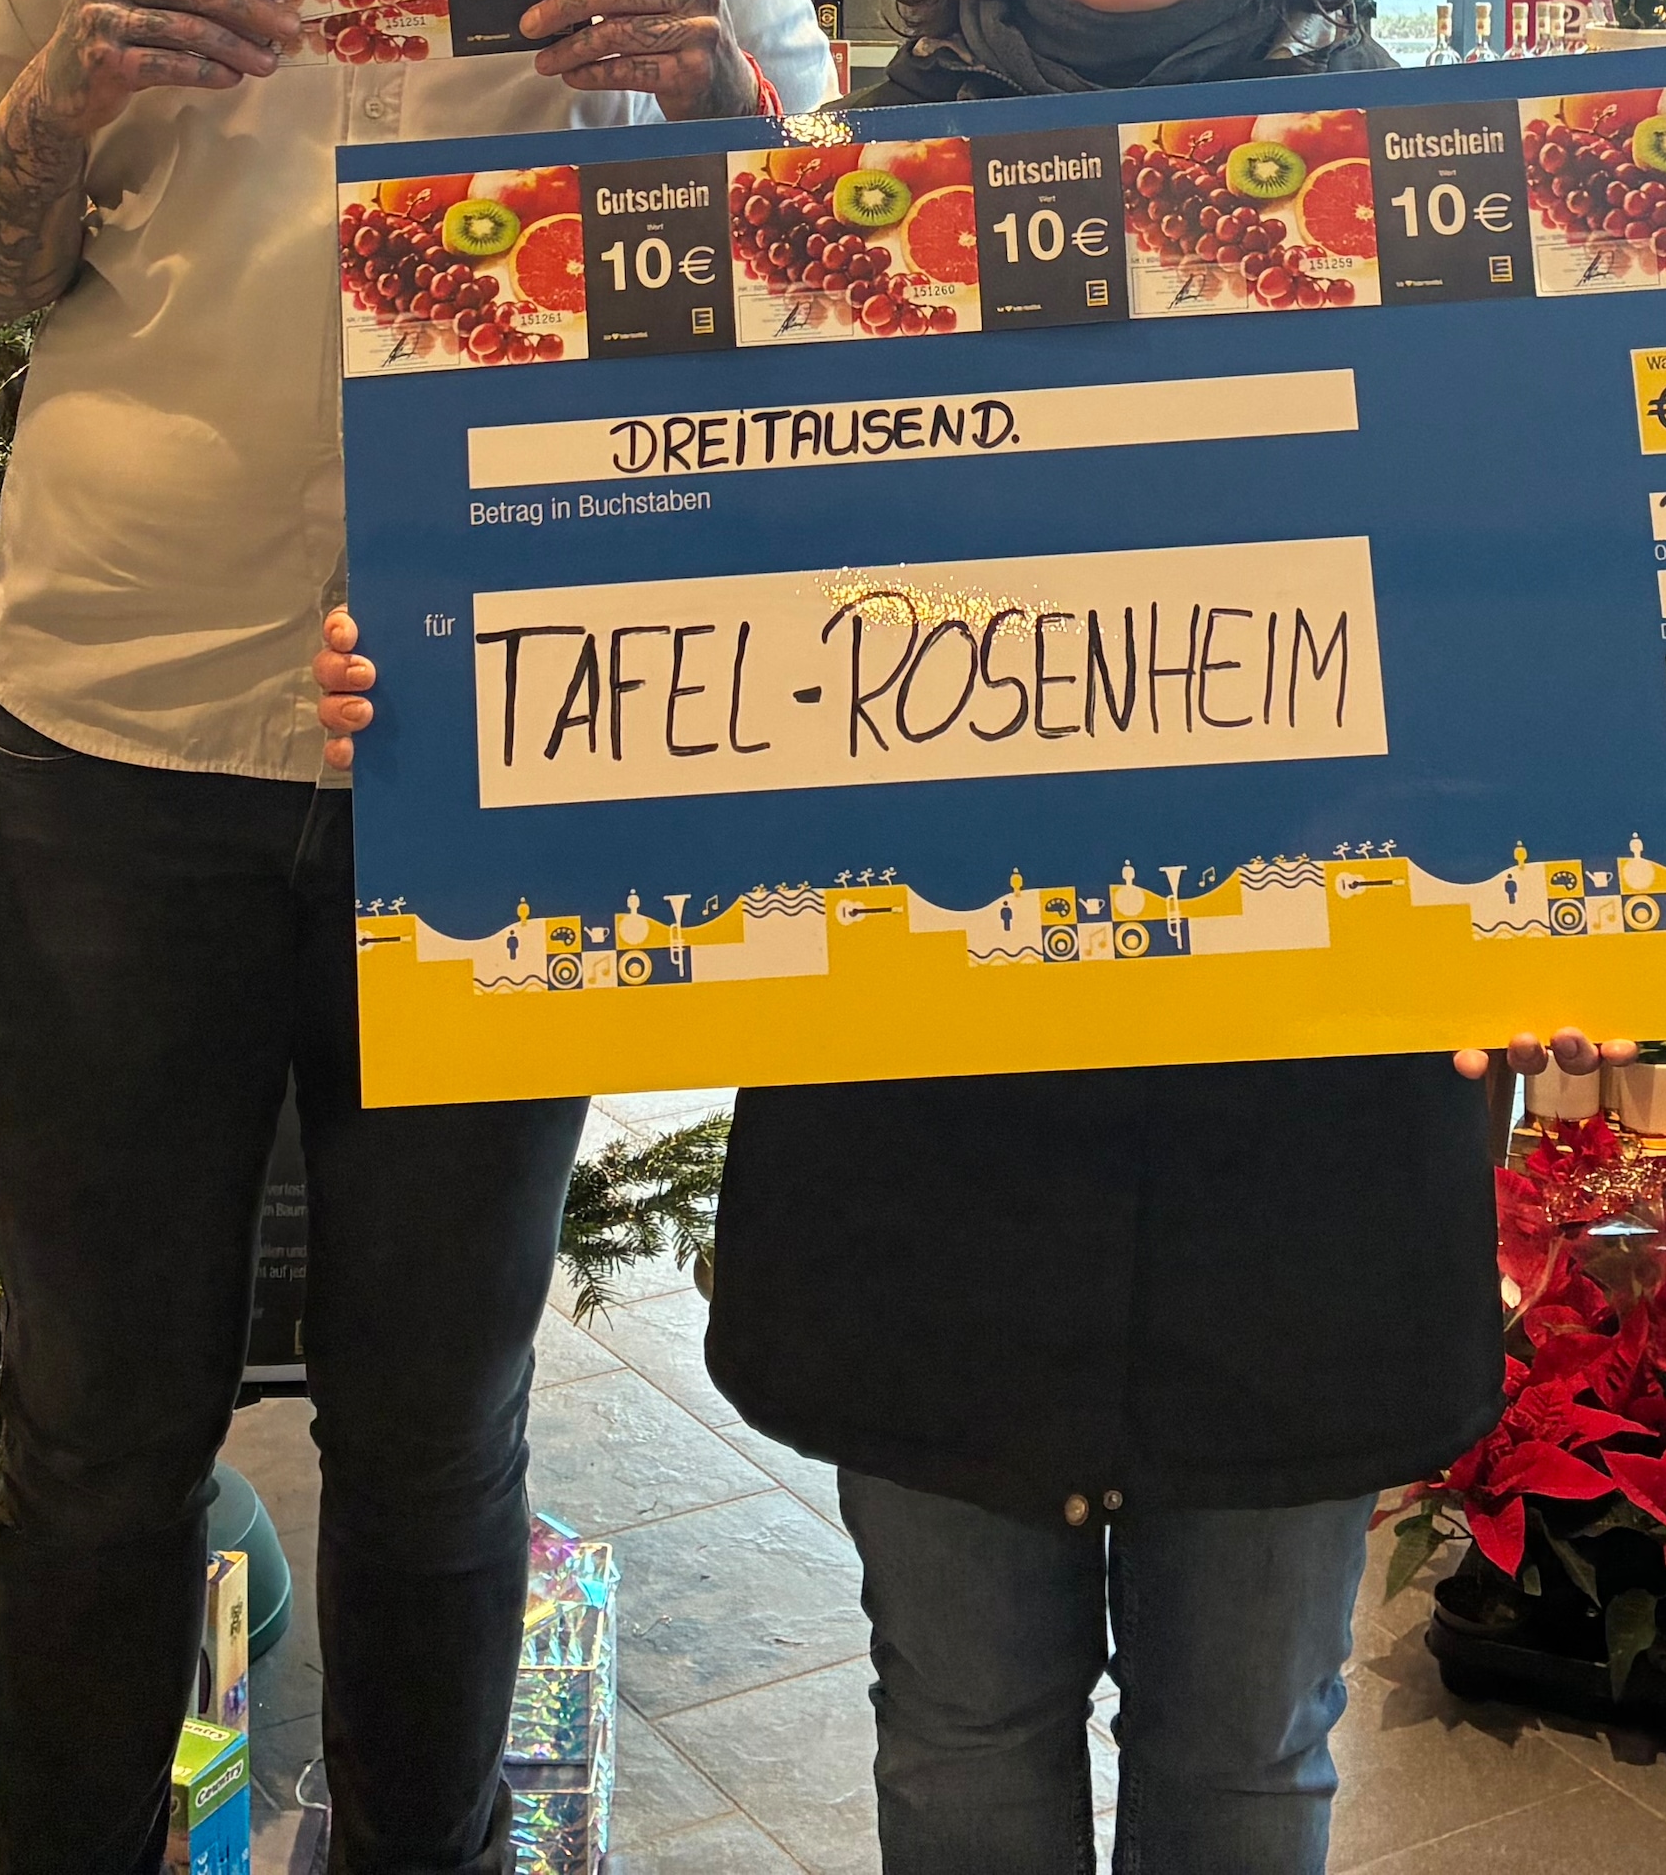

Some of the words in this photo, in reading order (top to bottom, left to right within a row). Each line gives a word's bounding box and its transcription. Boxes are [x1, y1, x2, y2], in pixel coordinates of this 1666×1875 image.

[1384, 126, 1504, 161] Gutschein
[988, 151, 1102, 187] Gutschein
[596, 181, 710, 216] Gutschein
[1391, 183, 1514, 237] 10€
[993, 209, 1109, 263] 10€
[601, 238, 716, 291] 10€
[1309, 258, 1353, 270] 151259
[913, 285, 955, 298] 151260
[520, 313, 563, 326] 151261
[470, 496, 544, 529] Betrag
[550, 495, 572, 520] in
[578, 488, 712, 519] Buchstaben
[424, 611, 456, 638] für
[197, 1762, 243, 1805] Country
